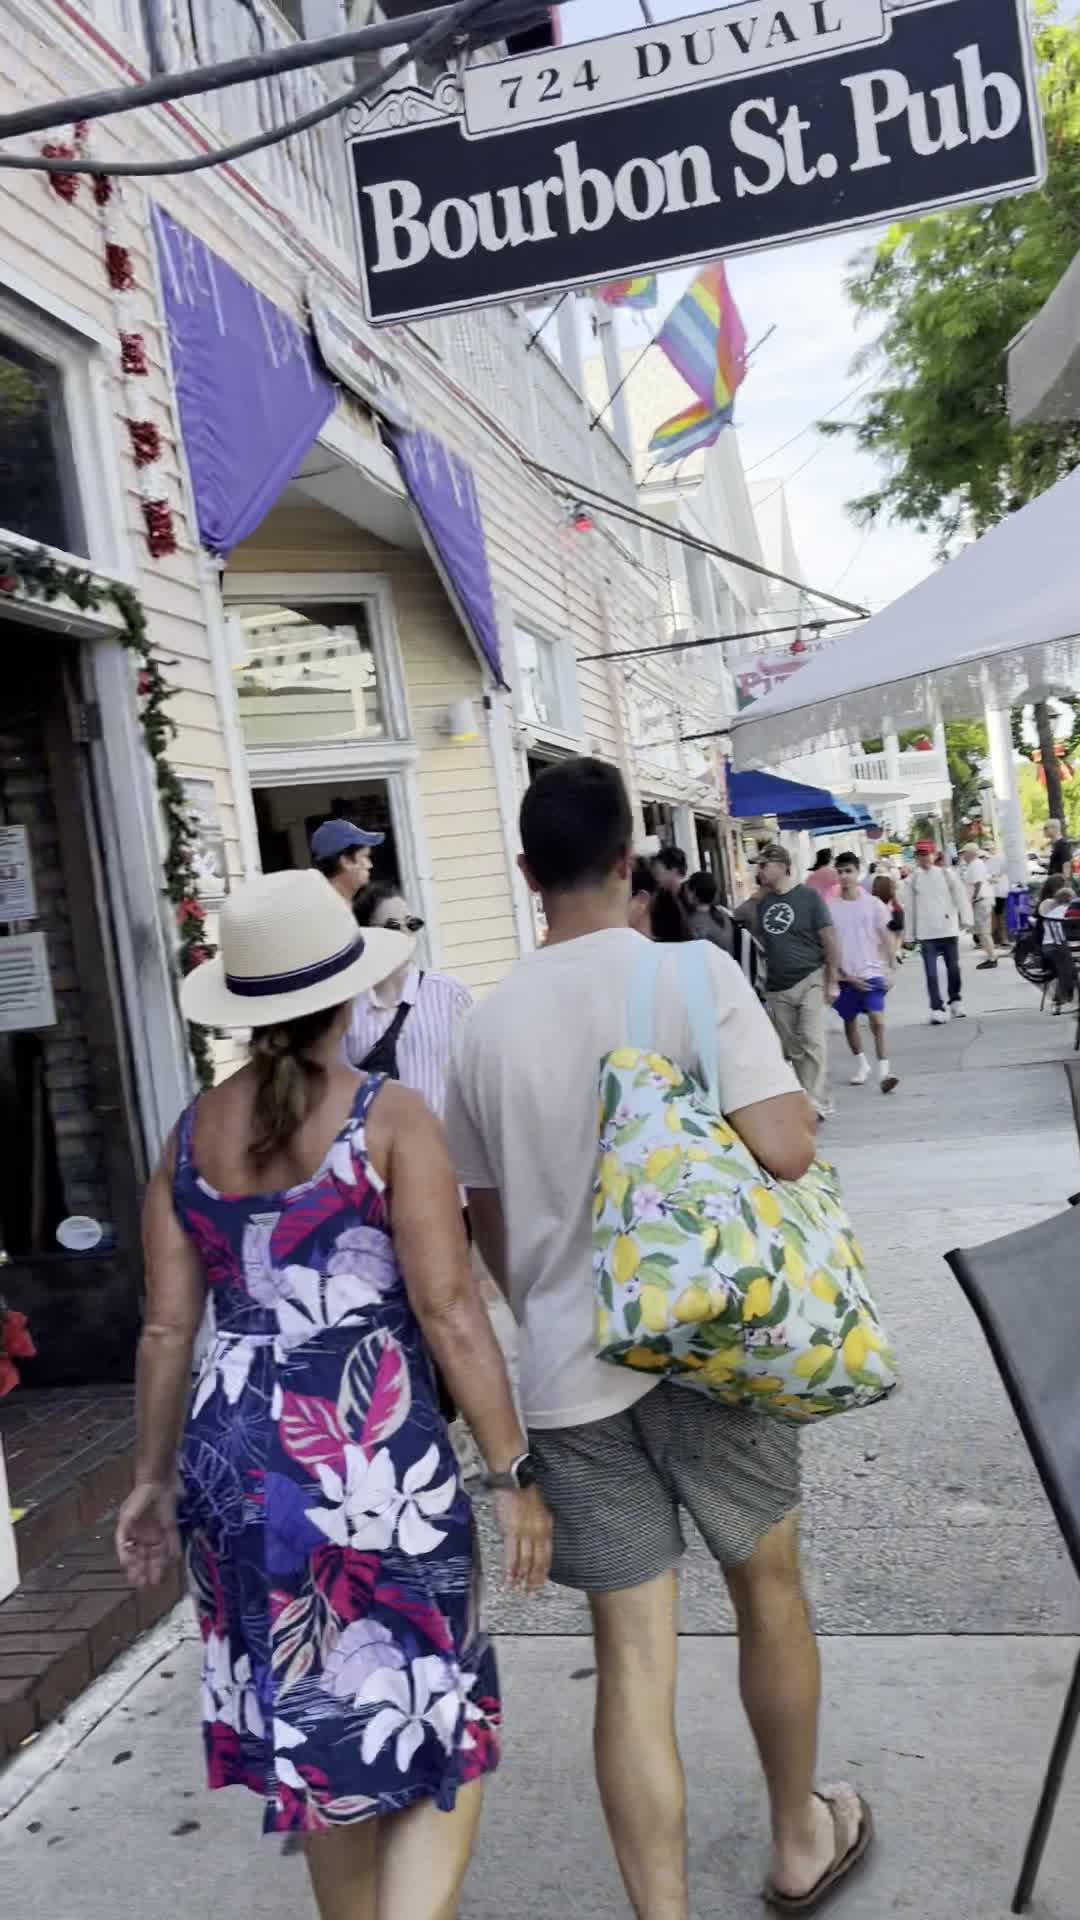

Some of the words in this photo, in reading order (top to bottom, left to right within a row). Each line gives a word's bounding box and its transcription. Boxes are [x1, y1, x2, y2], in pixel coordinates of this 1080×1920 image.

[500, 60, 600, 108] 724
[634, 1, 842, 80] DUVAL
[362, 141, 721, 273] Bourbon
[730, 97, 838, 197] St.
[840, 43, 1022, 171] Pub
